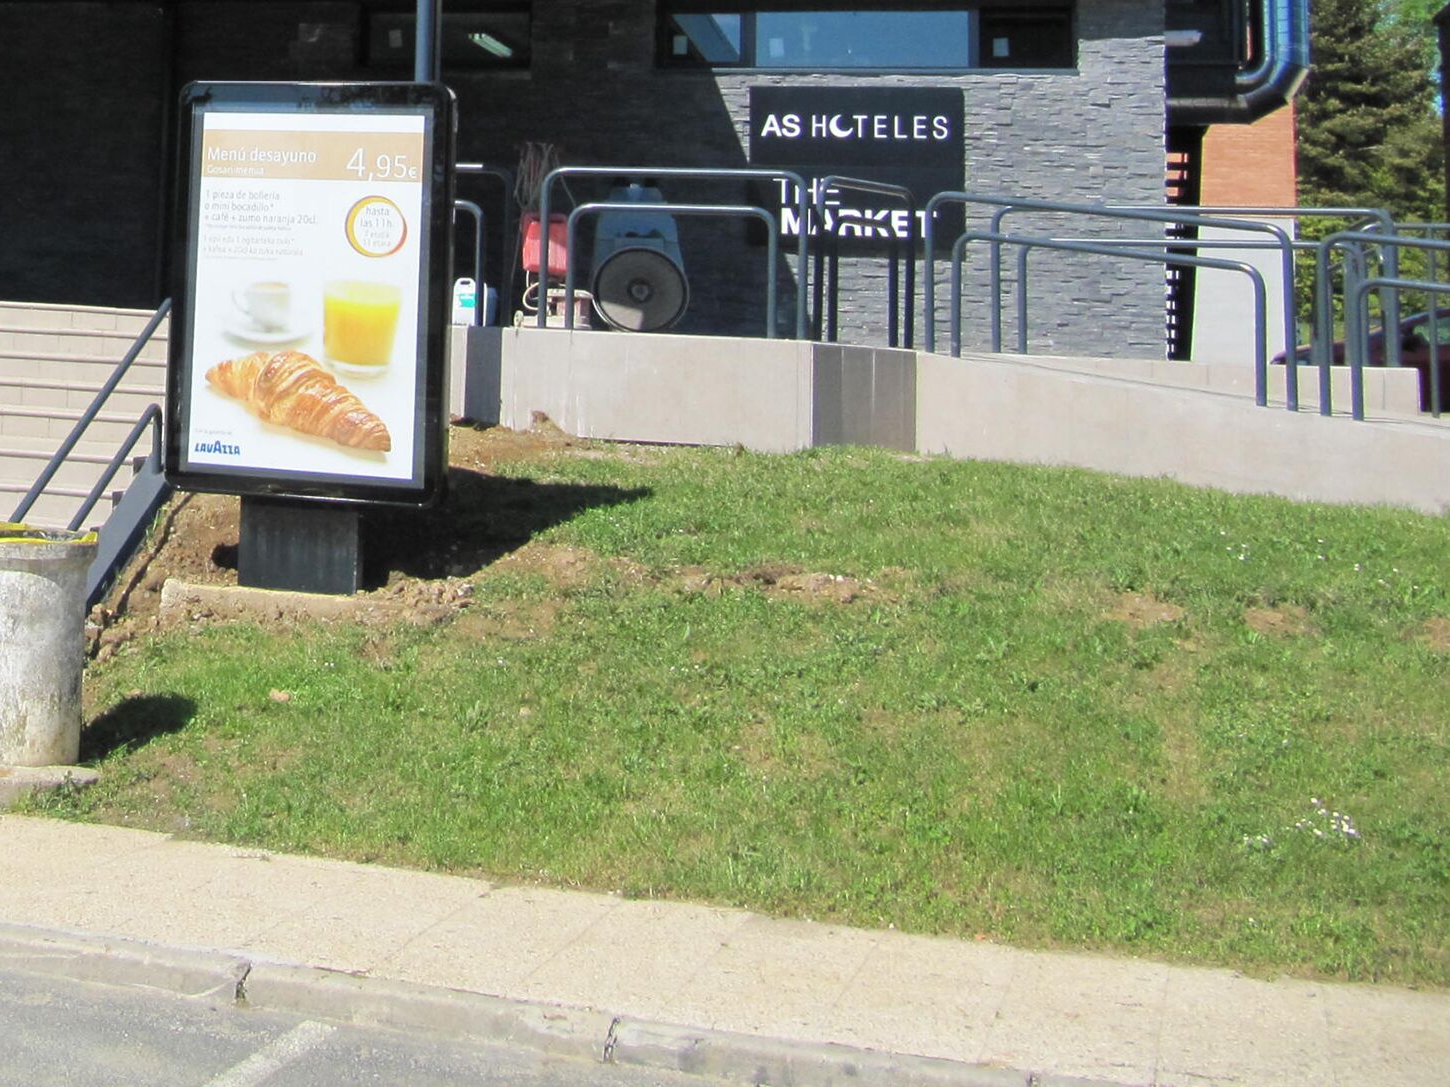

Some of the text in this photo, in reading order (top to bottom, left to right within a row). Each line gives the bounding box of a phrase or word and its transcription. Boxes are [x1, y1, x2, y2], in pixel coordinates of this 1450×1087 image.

[760, 114, 801, 138] AS
[207, 146, 317, 167] Menú desayuno
